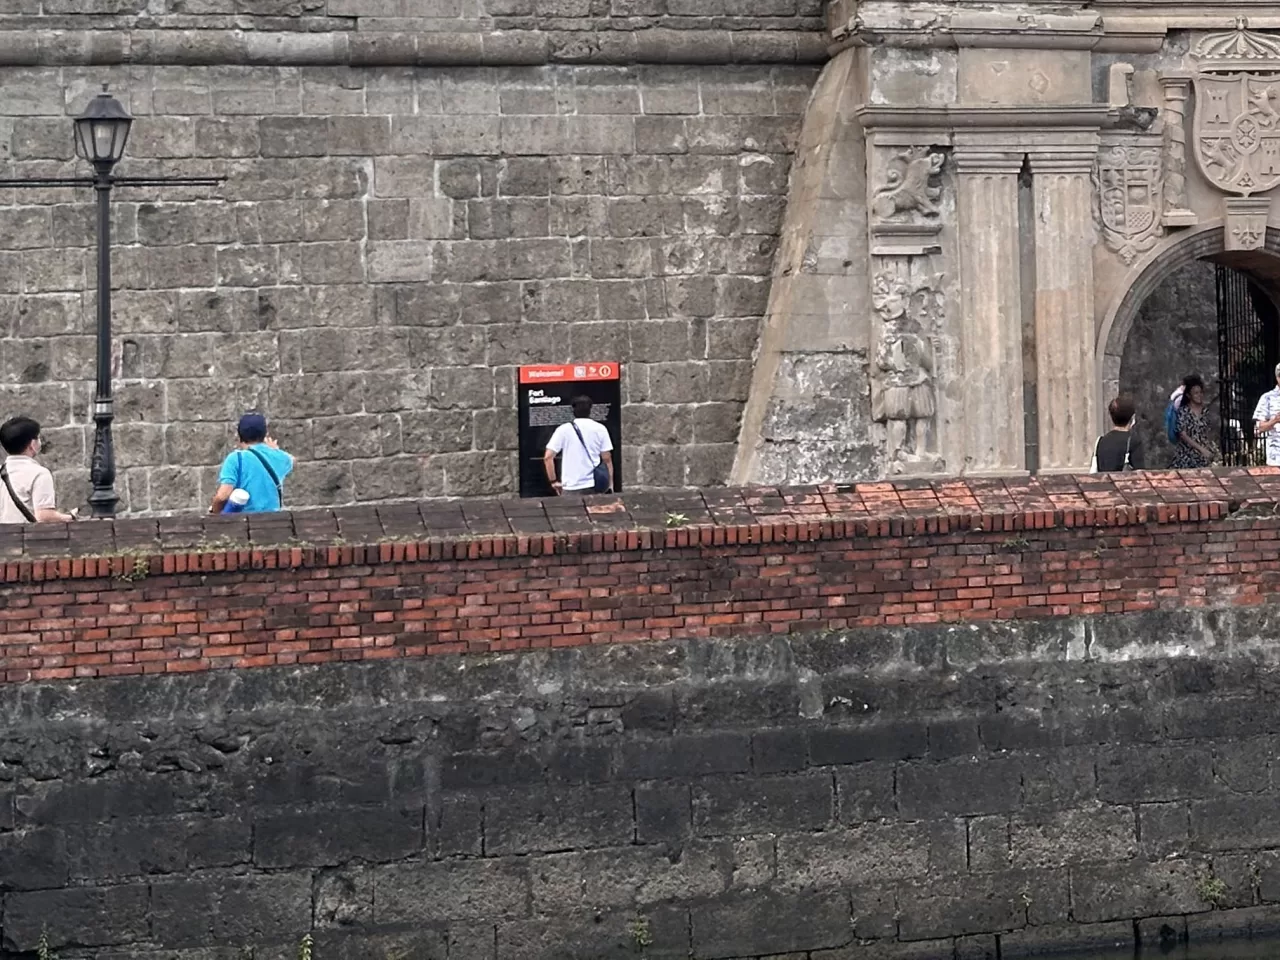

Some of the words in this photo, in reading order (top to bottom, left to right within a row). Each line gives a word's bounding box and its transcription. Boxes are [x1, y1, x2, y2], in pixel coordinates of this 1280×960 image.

[528, 369, 564, 378] Welcome!
[528, 389, 544, 397] Fort
[529, 396, 561, 404] Santiago
